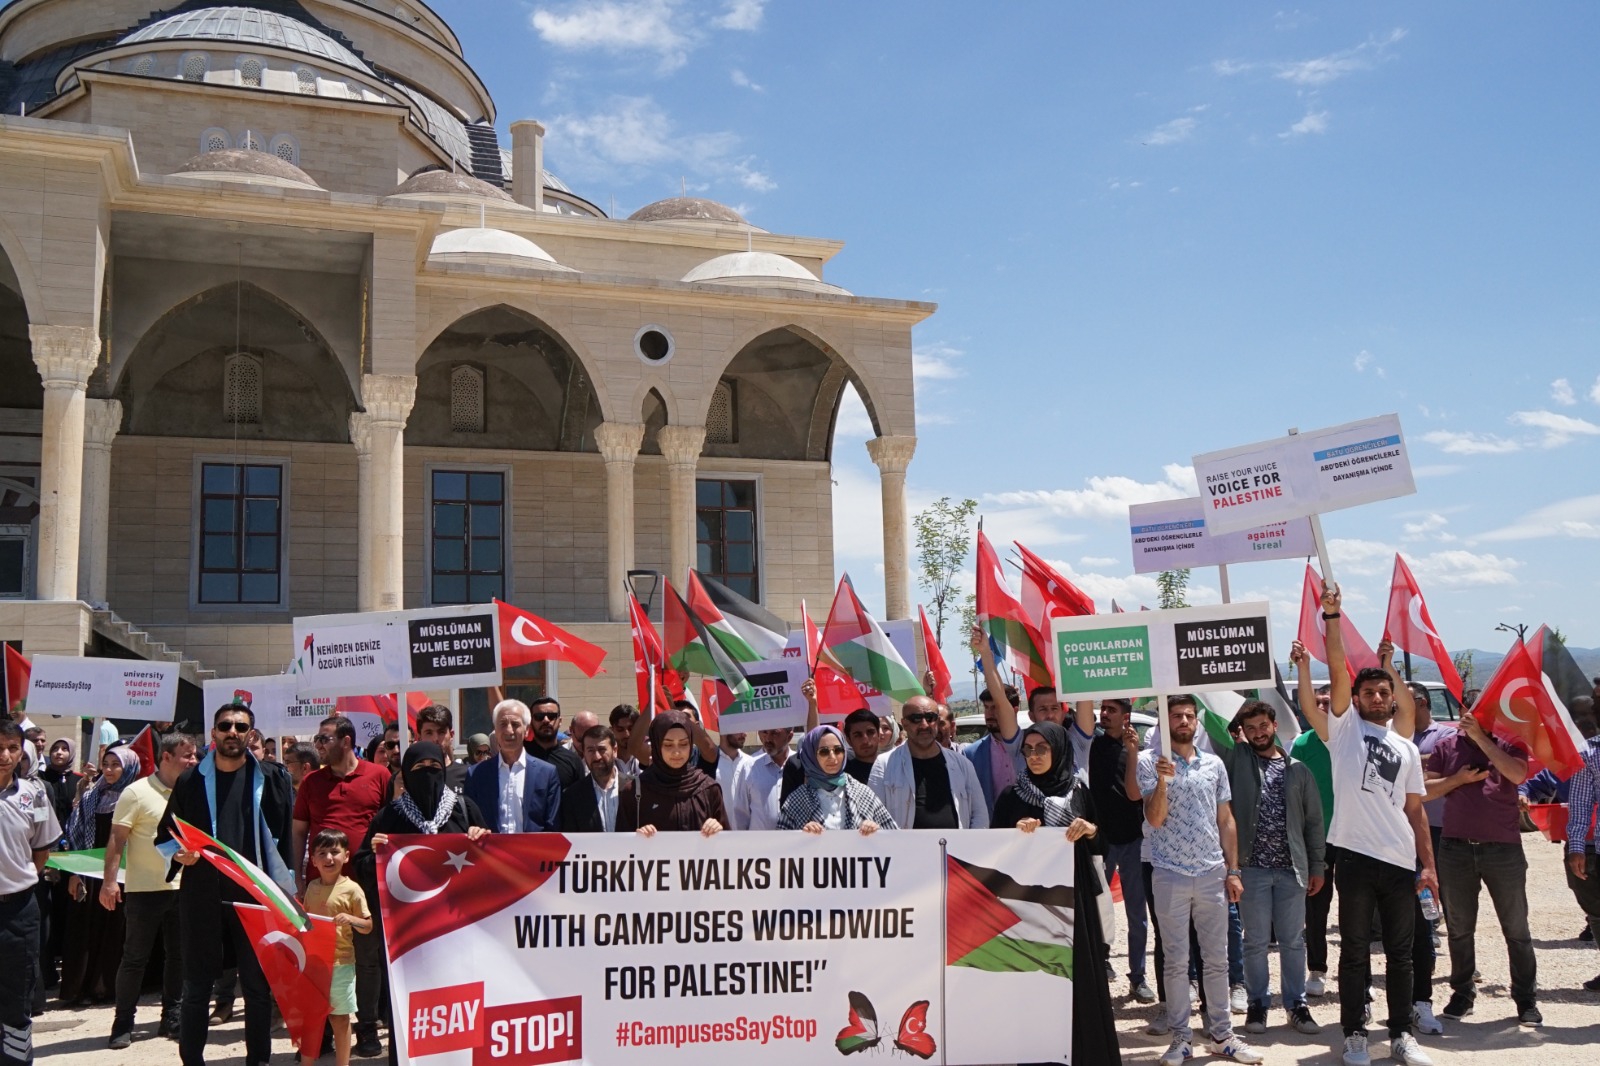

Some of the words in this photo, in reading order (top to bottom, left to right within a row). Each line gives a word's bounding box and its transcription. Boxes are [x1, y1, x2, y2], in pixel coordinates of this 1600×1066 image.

[1206, 472, 1229, 483] RAISE
[1231, 468, 1252, 478] YOUR
[1208, 478, 1250, 496] VOICE
[1253, 472, 1281, 487] FOR
[1213, 486, 1282, 509] PALESTINE
[1247, 528, 1285, 541] against
[1253, 539, 1282, 550] Isreal
[420, 622, 482, 637] MÜSLÜMAN
[1187, 625, 1255, 641] MÜSLÜMAN
[316, 642, 354, 656] NEHİRDEN
[355, 638, 381, 651] DENİZE
[413, 640, 450, 653] ZULME
[454, 638, 491, 651] BOYUN
[1064, 638, 1143, 655] ÇOCUKLARDAN
[1179, 645, 1220, 659] ZULME
[1223, 642, 1265, 656] BOYUN
[318, 656, 343, 670] ÖZGÜR
[432, 654, 474, 668] EĞMEZ!
[1065, 656, 1079, 666] VE
[1082, 652, 1144, 665] ADALETTEN
[1083, 666, 1128, 678] TARAFIZ
[1201, 660, 1246, 675] EĞMEZ!
[123, 670, 164, 681] university
[34, 679, 92, 692] #CampusesSayStop
[125, 680, 161, 689] students
[126, 689, 157, 698] against
[129, 698, 153, 706] Isreal
[287, 705, 302, 717] FREE
[679, 857, 771, 891] WALKS
[779, 857, 804, 889] IN
[813, 856, 891, 889] UNITY
[514, 914, 585, 949] WITH
[594, 910, 743, 946] CAMPUSES
[752, 907, 914, 941] WORLDWIDE
[605, 965, 655, 1000] FOR
[412, 998, 480, 1040] #SAY
[490, 1010, 574, 1058] STOP!
[616, 1015, 817, 1049] #CampusesSayStop
